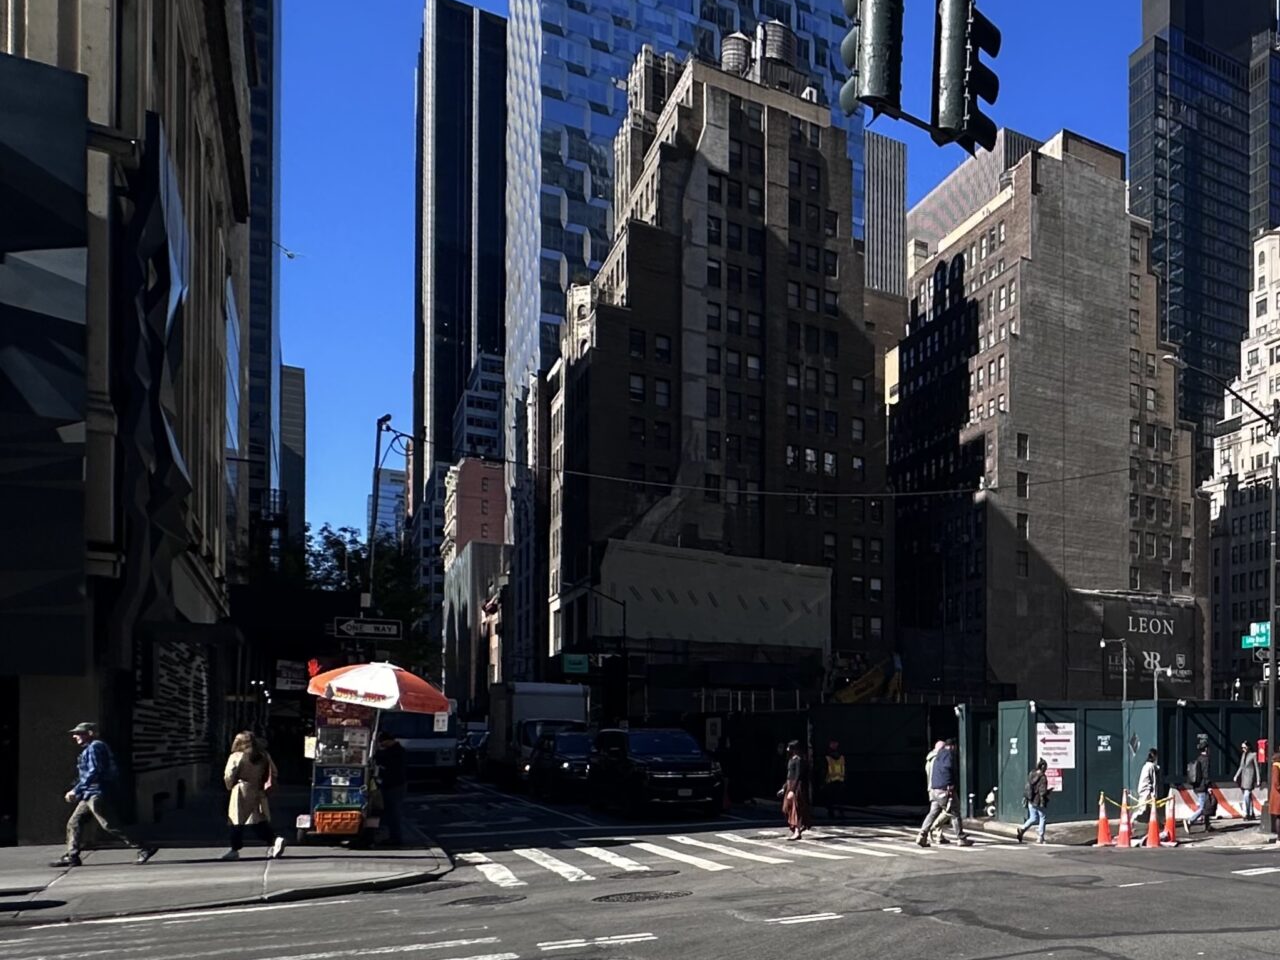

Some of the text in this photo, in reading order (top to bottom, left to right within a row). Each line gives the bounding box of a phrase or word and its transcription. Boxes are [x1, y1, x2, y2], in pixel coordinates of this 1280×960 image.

[345, 623, 393, 633] ONE WAY
[1128, 616, 1174, 635] LEON
